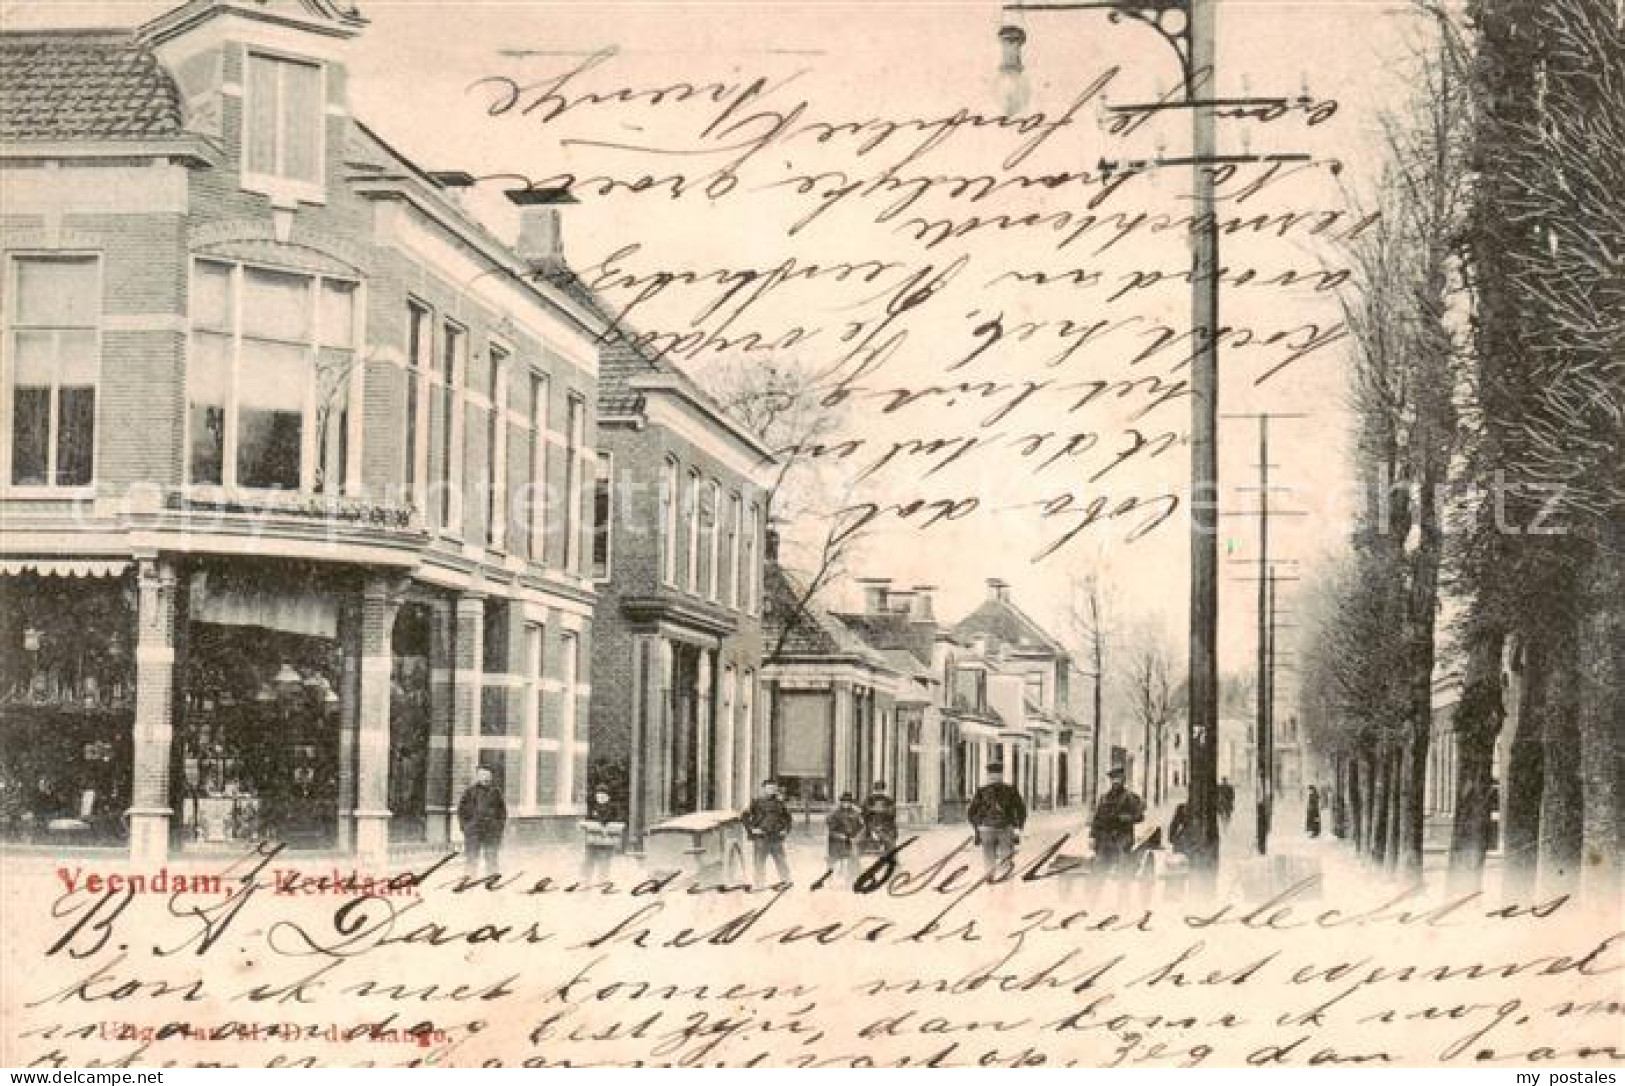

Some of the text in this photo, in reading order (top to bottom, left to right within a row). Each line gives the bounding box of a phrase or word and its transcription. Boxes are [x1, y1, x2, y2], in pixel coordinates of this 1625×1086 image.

[780, 66, 1120, 172] familie
[1015, 431, 1099, 476] de
[57, 867, 421, 900] Veendam, Kerklaan.
[268, 894, 556, 958] Daar
[1184, 873, 1484, 929] slecht
[1485, 893, 1571, 919] is
[228, 958, 346, 1004] ik
[538, 952, 815, 1004] komen
[1122, 942, 1283, 991] het
[857, 1009, 1036, 1038] dan
[1244, 1034, 1402, 1065] dan
